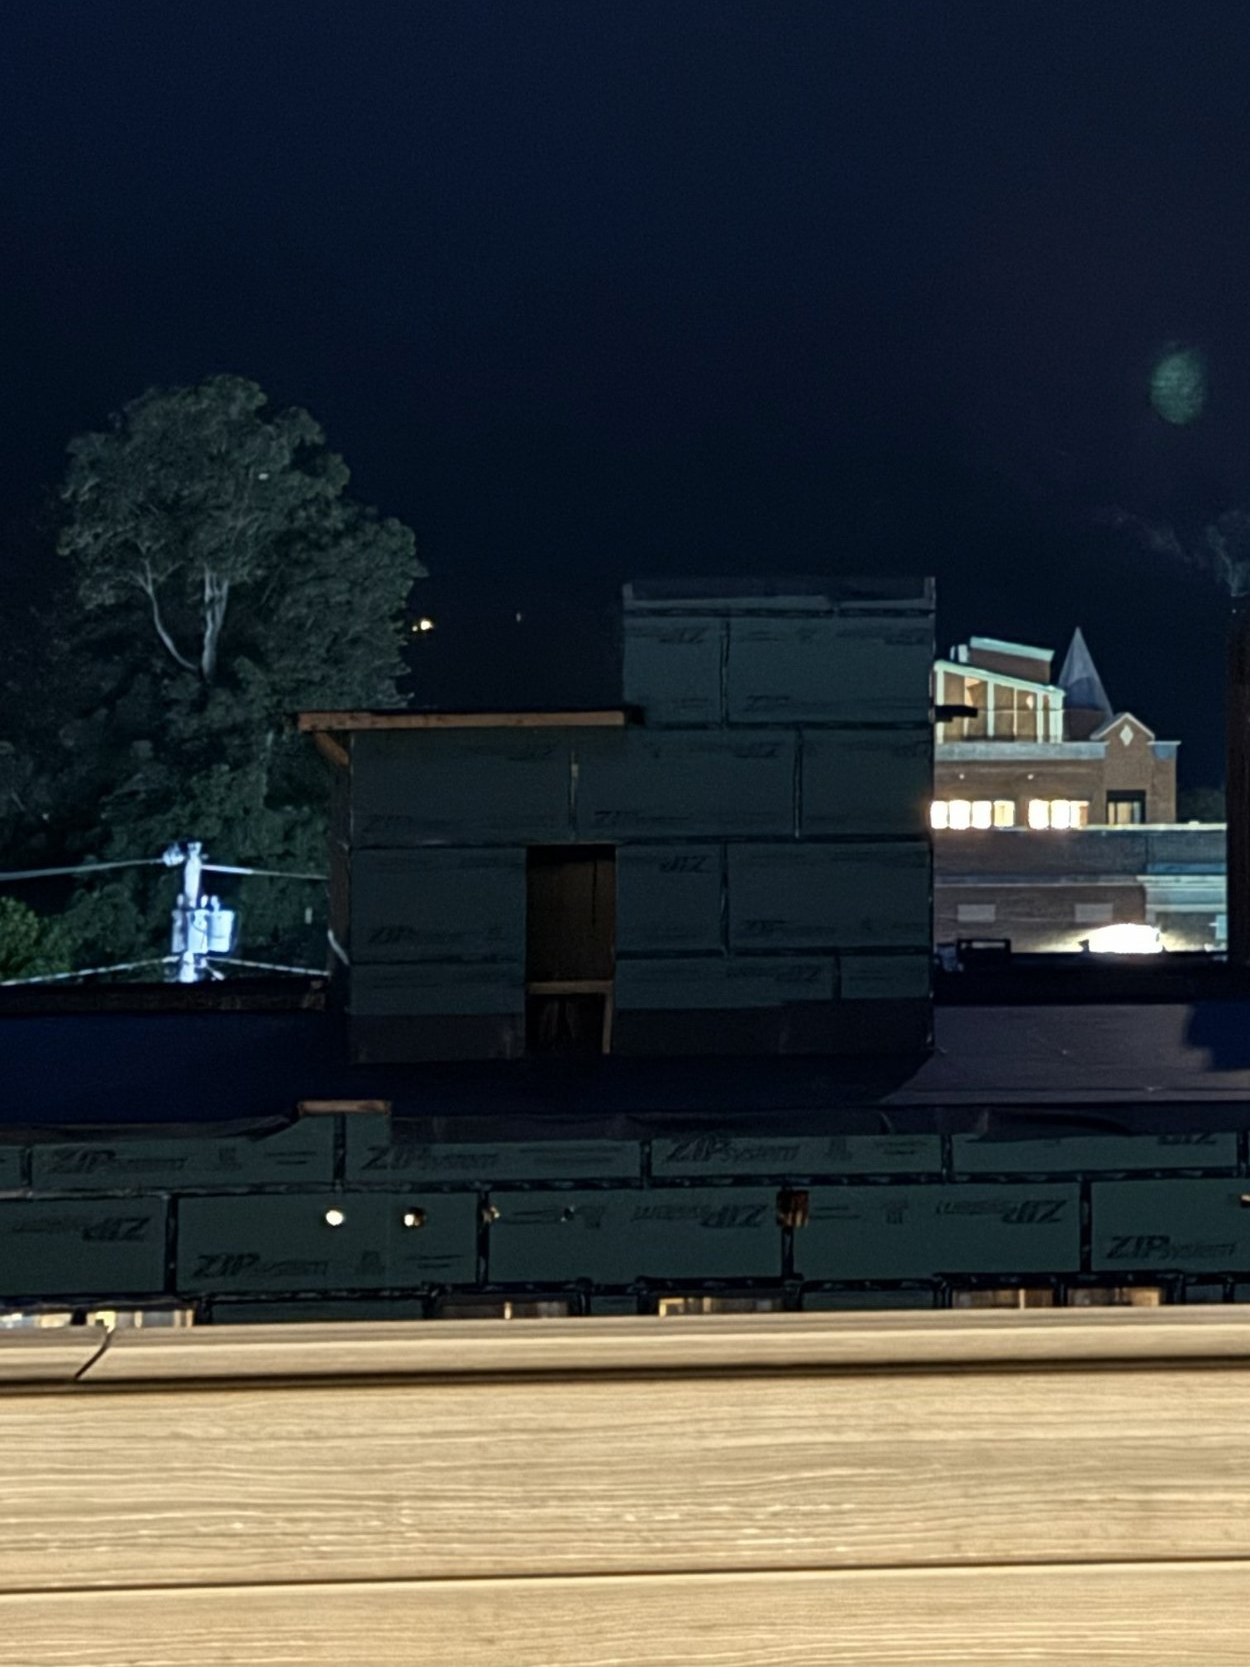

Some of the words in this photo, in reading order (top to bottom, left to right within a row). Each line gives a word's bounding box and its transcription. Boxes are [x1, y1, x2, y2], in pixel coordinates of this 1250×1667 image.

[1001, 1200, 1068, 1224] ZIP
[1106, 1235, 1171, 1259] ZIP
[191, 1252, 261, 1279] ZIP
